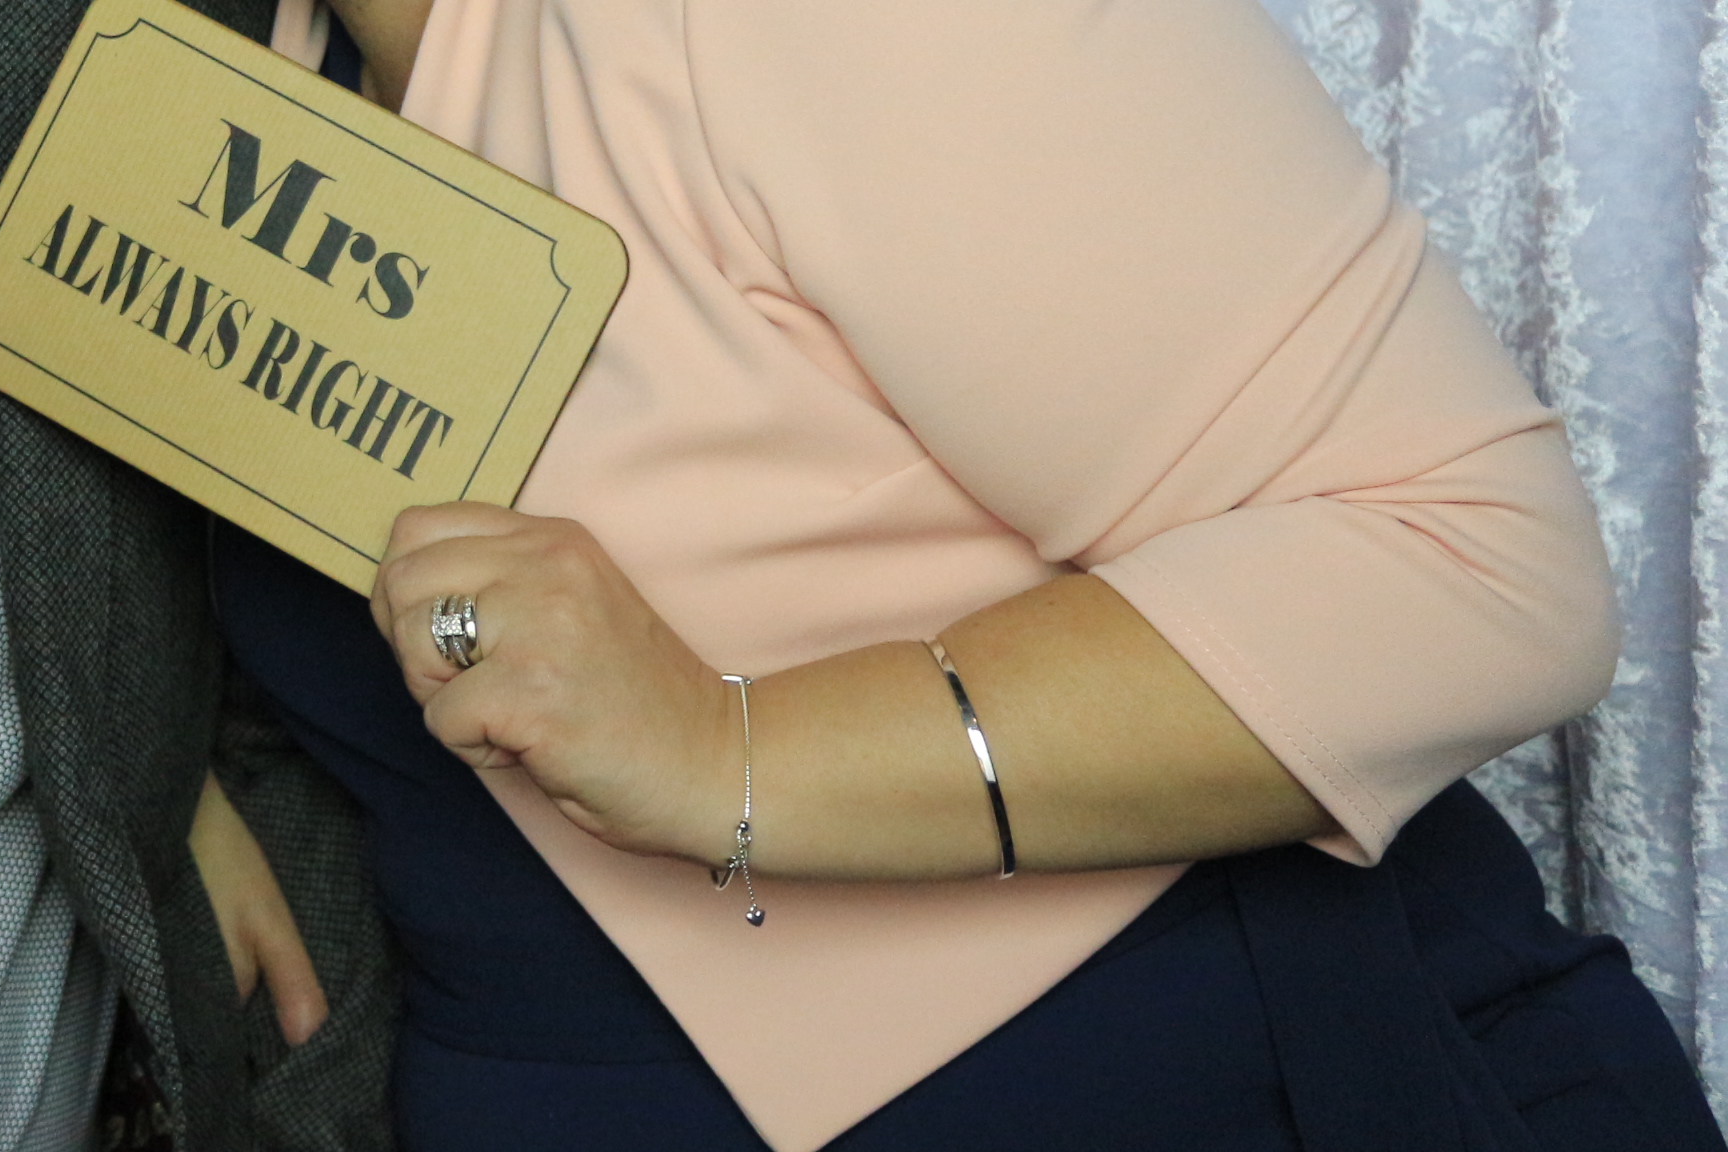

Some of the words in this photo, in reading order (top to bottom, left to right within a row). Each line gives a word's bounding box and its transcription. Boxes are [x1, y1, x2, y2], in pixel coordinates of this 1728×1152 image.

[178, 118, 431, 321] Mrs
[23, 203, 256, 370] ALWAYS
[238, 316, 454, 481] RIGHT
